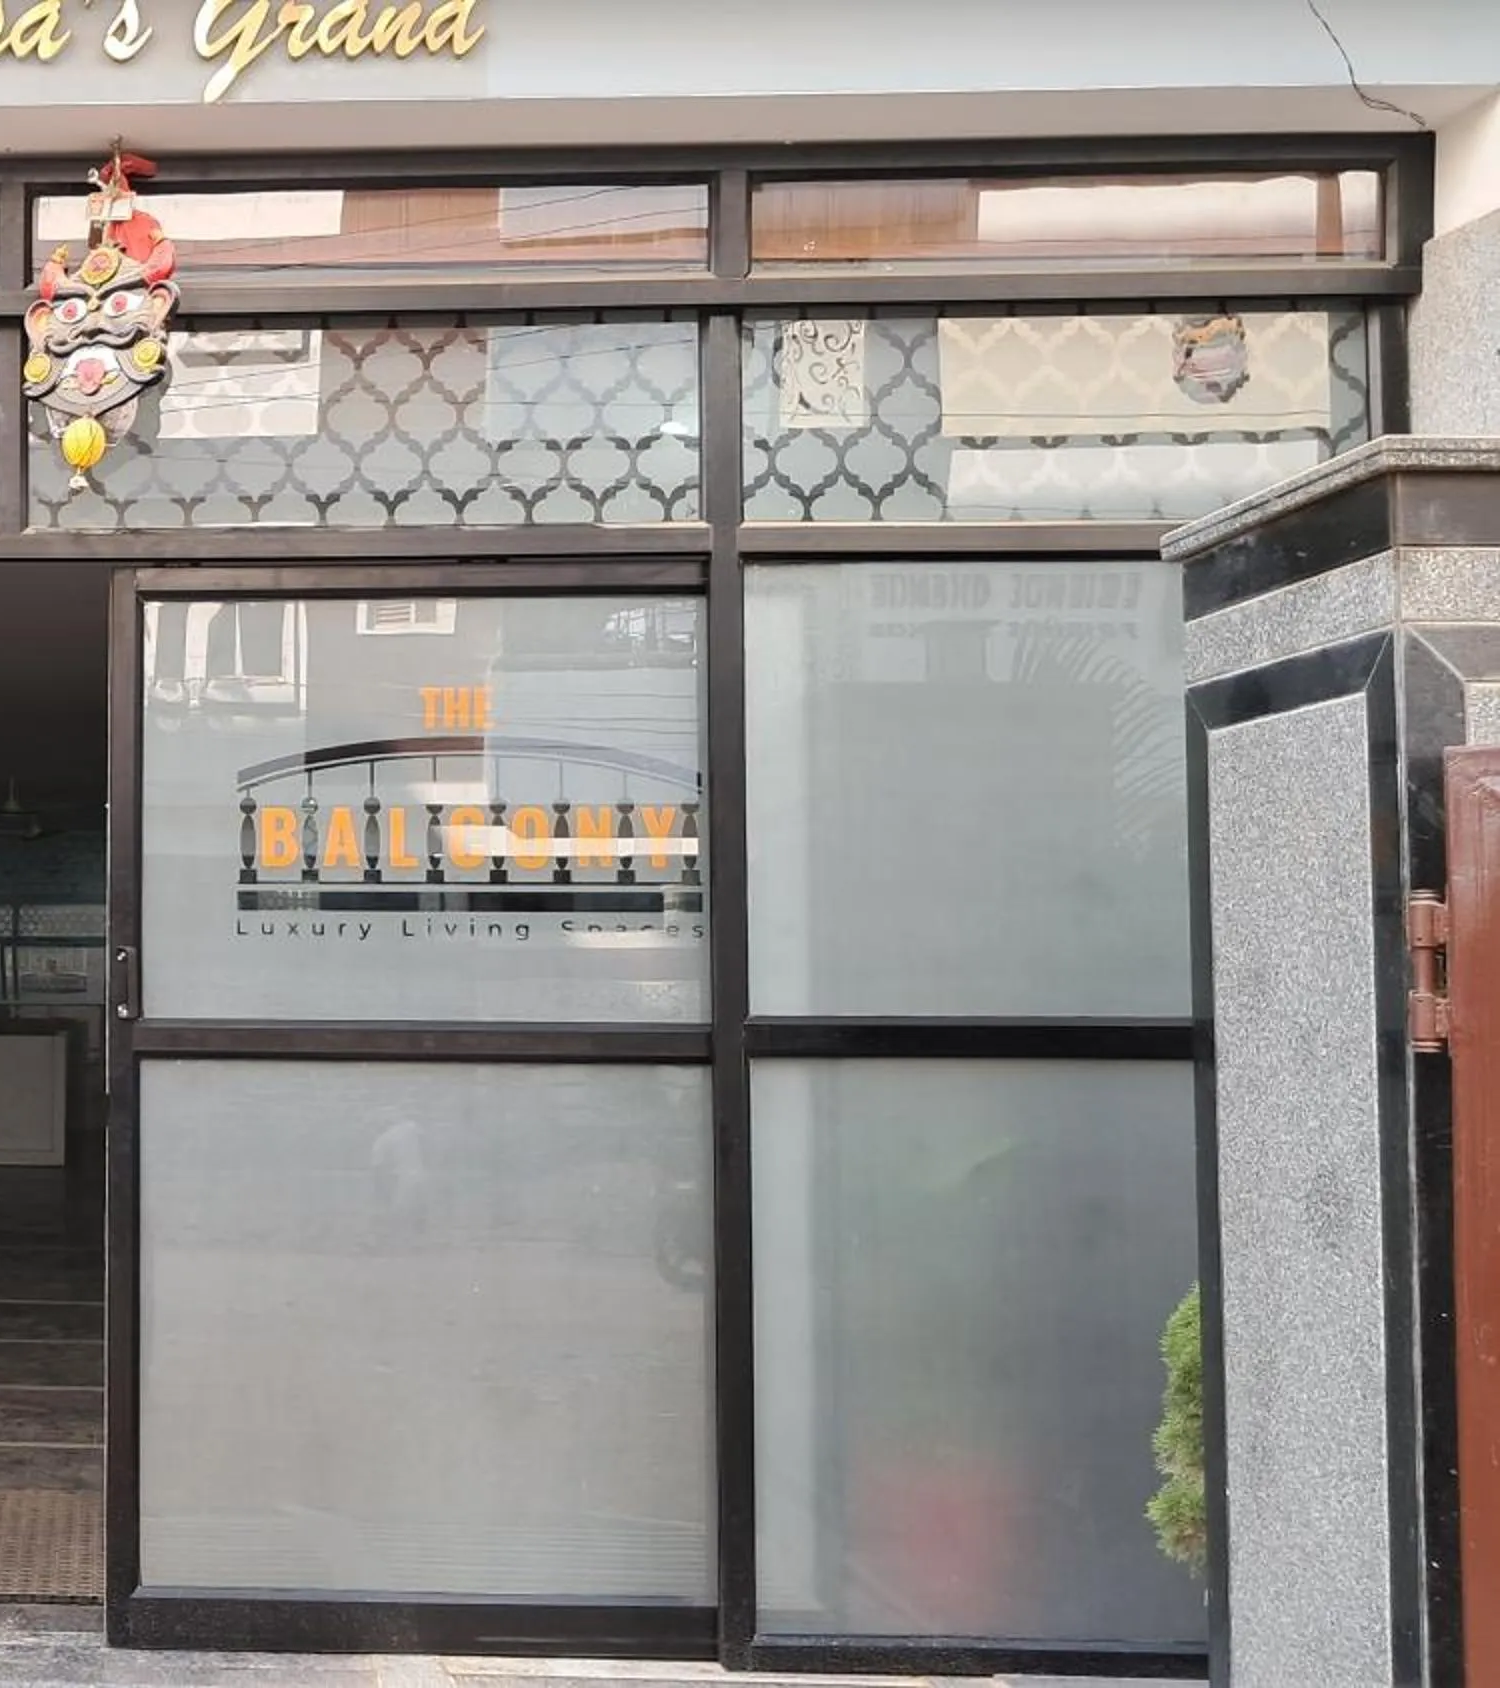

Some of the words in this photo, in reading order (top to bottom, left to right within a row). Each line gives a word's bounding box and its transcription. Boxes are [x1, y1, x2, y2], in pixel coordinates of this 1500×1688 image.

[194, 0, 485, 103] Grand
[419, 686, 493, 729] THE
[260, 806, 677, 869] BALCONY
[236, 919, 372, 940] Luxury
[402, 919, 531, 940] Living
